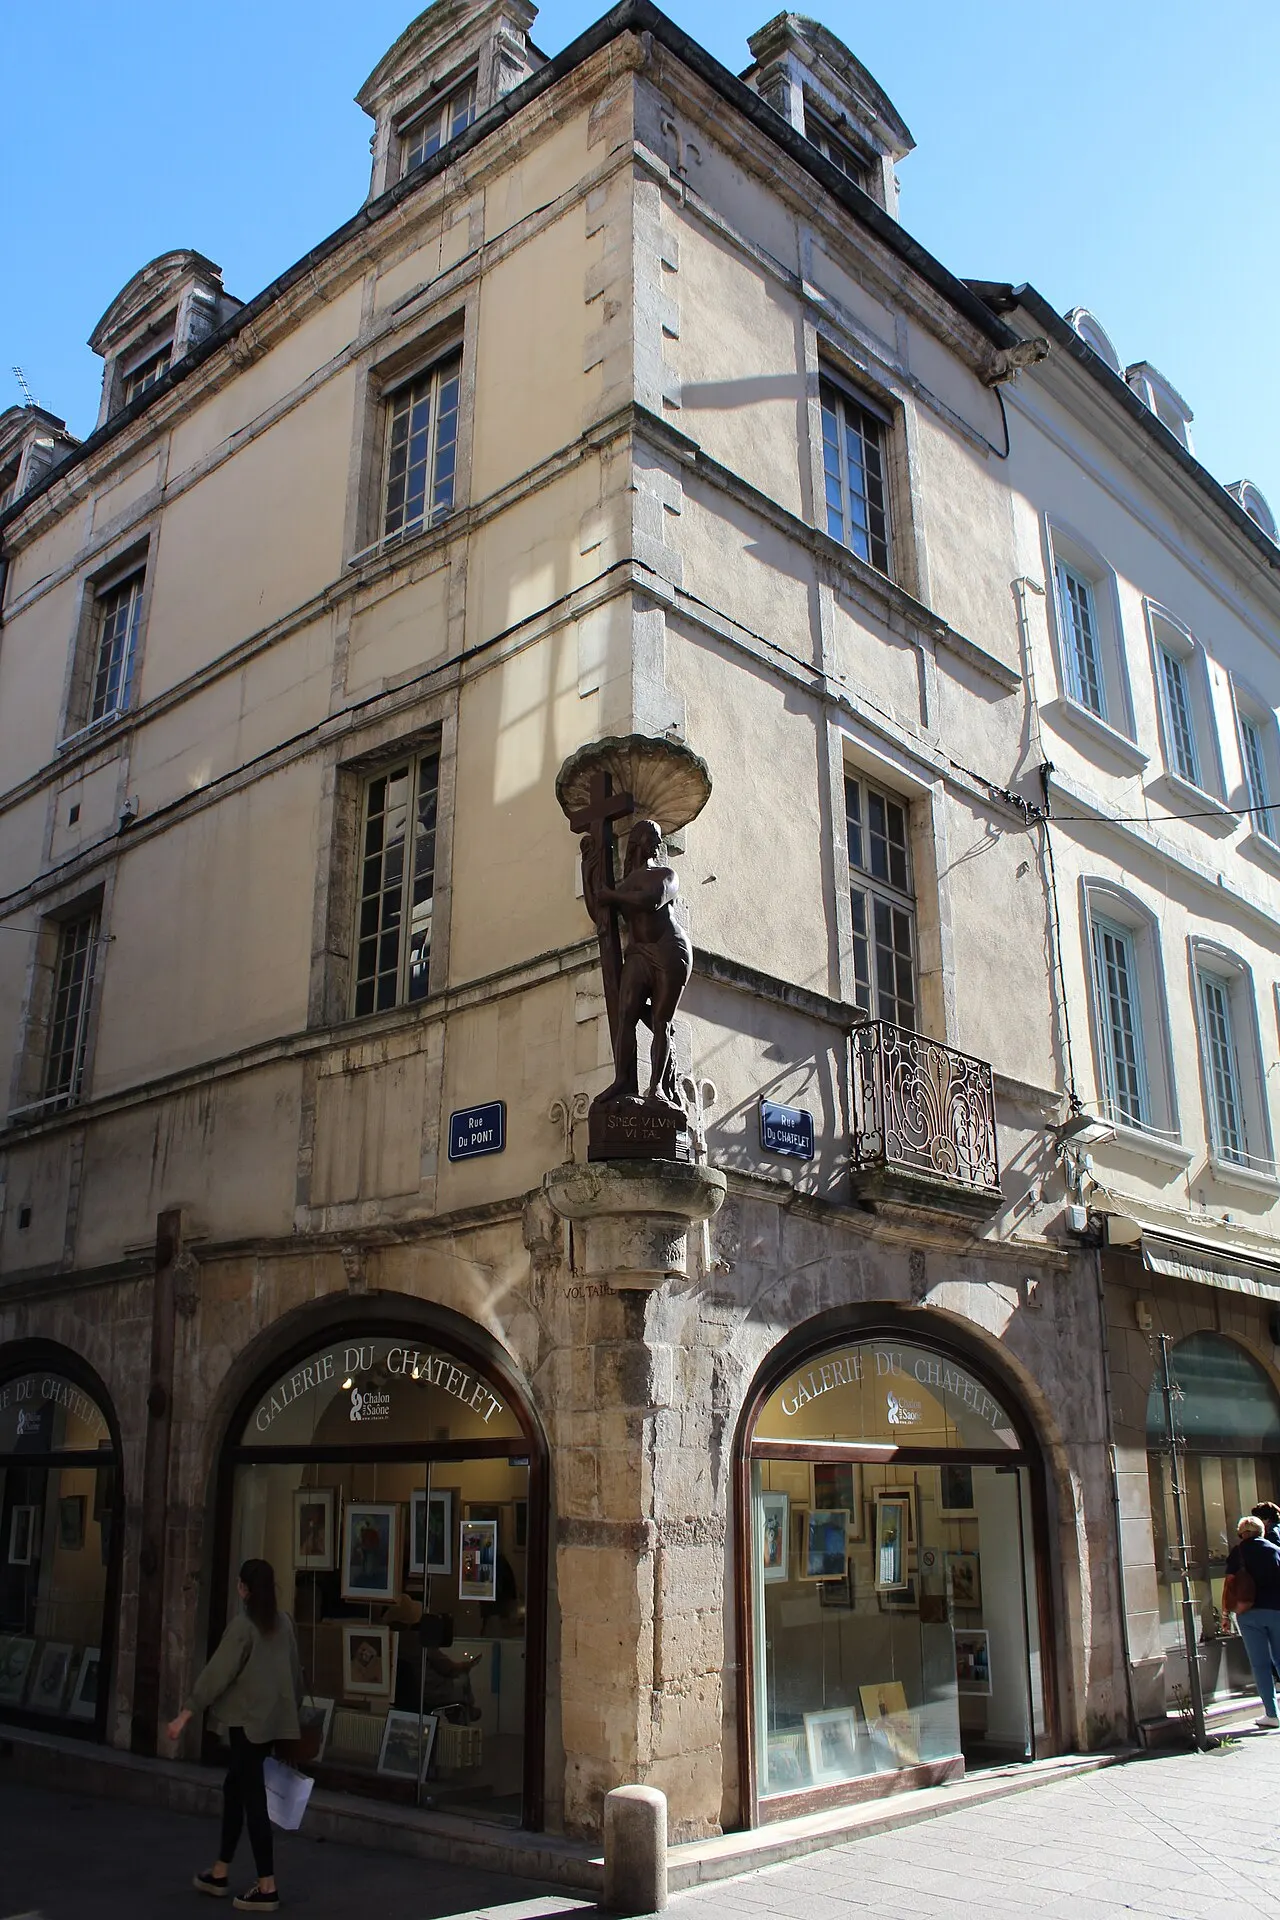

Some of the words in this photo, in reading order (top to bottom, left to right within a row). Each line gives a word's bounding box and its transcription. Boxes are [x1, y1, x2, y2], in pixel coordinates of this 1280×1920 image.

[468, 1117, 483, 1129] Rue
[781, 1114, 796, 1128] Rue
[458, 1136, 468, 1148] Du
[471, 1129, 494, 1145] PONT
[767, 1127, 776, 1140] Du
[776, 1130, 810, 1148] CHATELET
[255, 1354, 336, 1432] GALERIE
[343, 1345, 375, 1374] DU
[386, 1347, 503, 1425] CHATELET
[780, 1354, 865, 1417] GALERIE
[874, 1351, 903, 1377] DU
[914, 1358, 1004, 1430] CHATELET
[363, 1391, 390, 1404] Chalon
[366, 1403, 390, 1416] Saône
